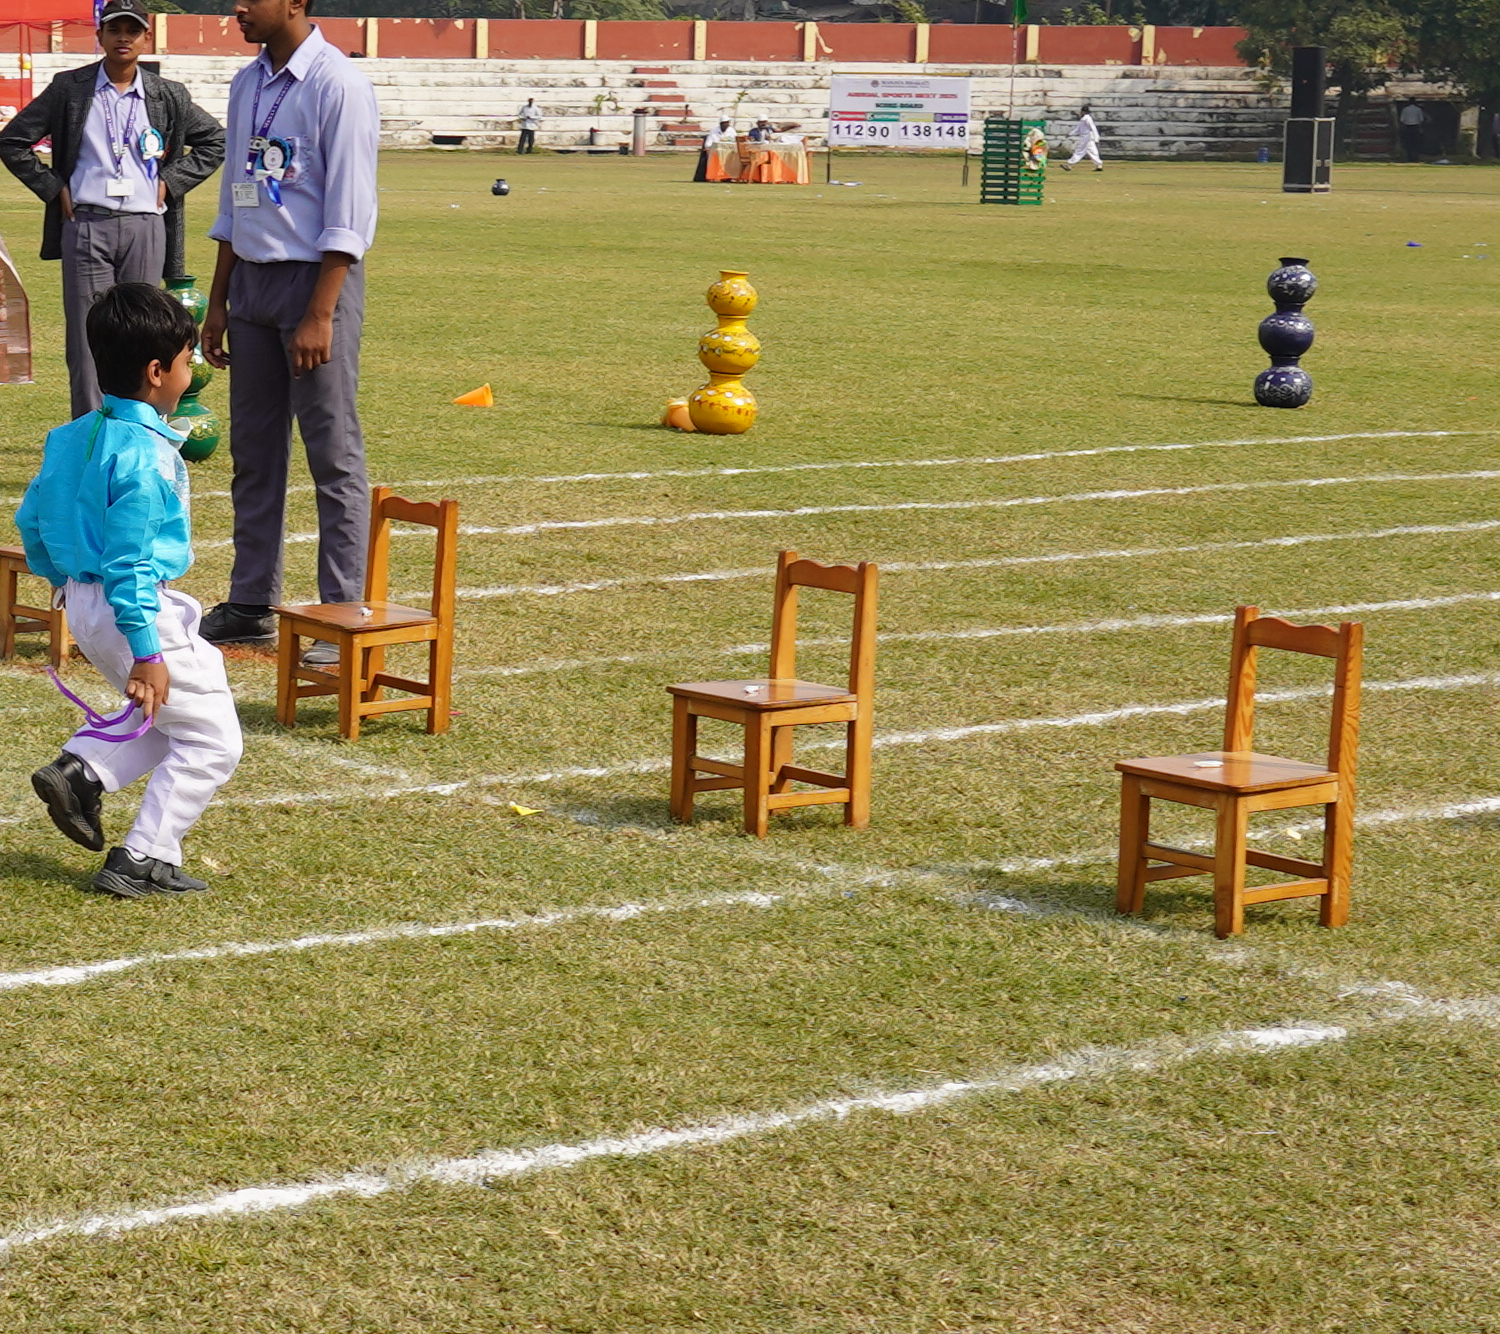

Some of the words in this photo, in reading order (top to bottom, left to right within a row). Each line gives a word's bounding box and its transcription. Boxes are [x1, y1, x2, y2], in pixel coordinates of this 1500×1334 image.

[832, 124, 863, 136] 112
[868, 125, 889, 138] 90
[901, 125, 932, 137] 138
[935, 125, 966, 138] 148
